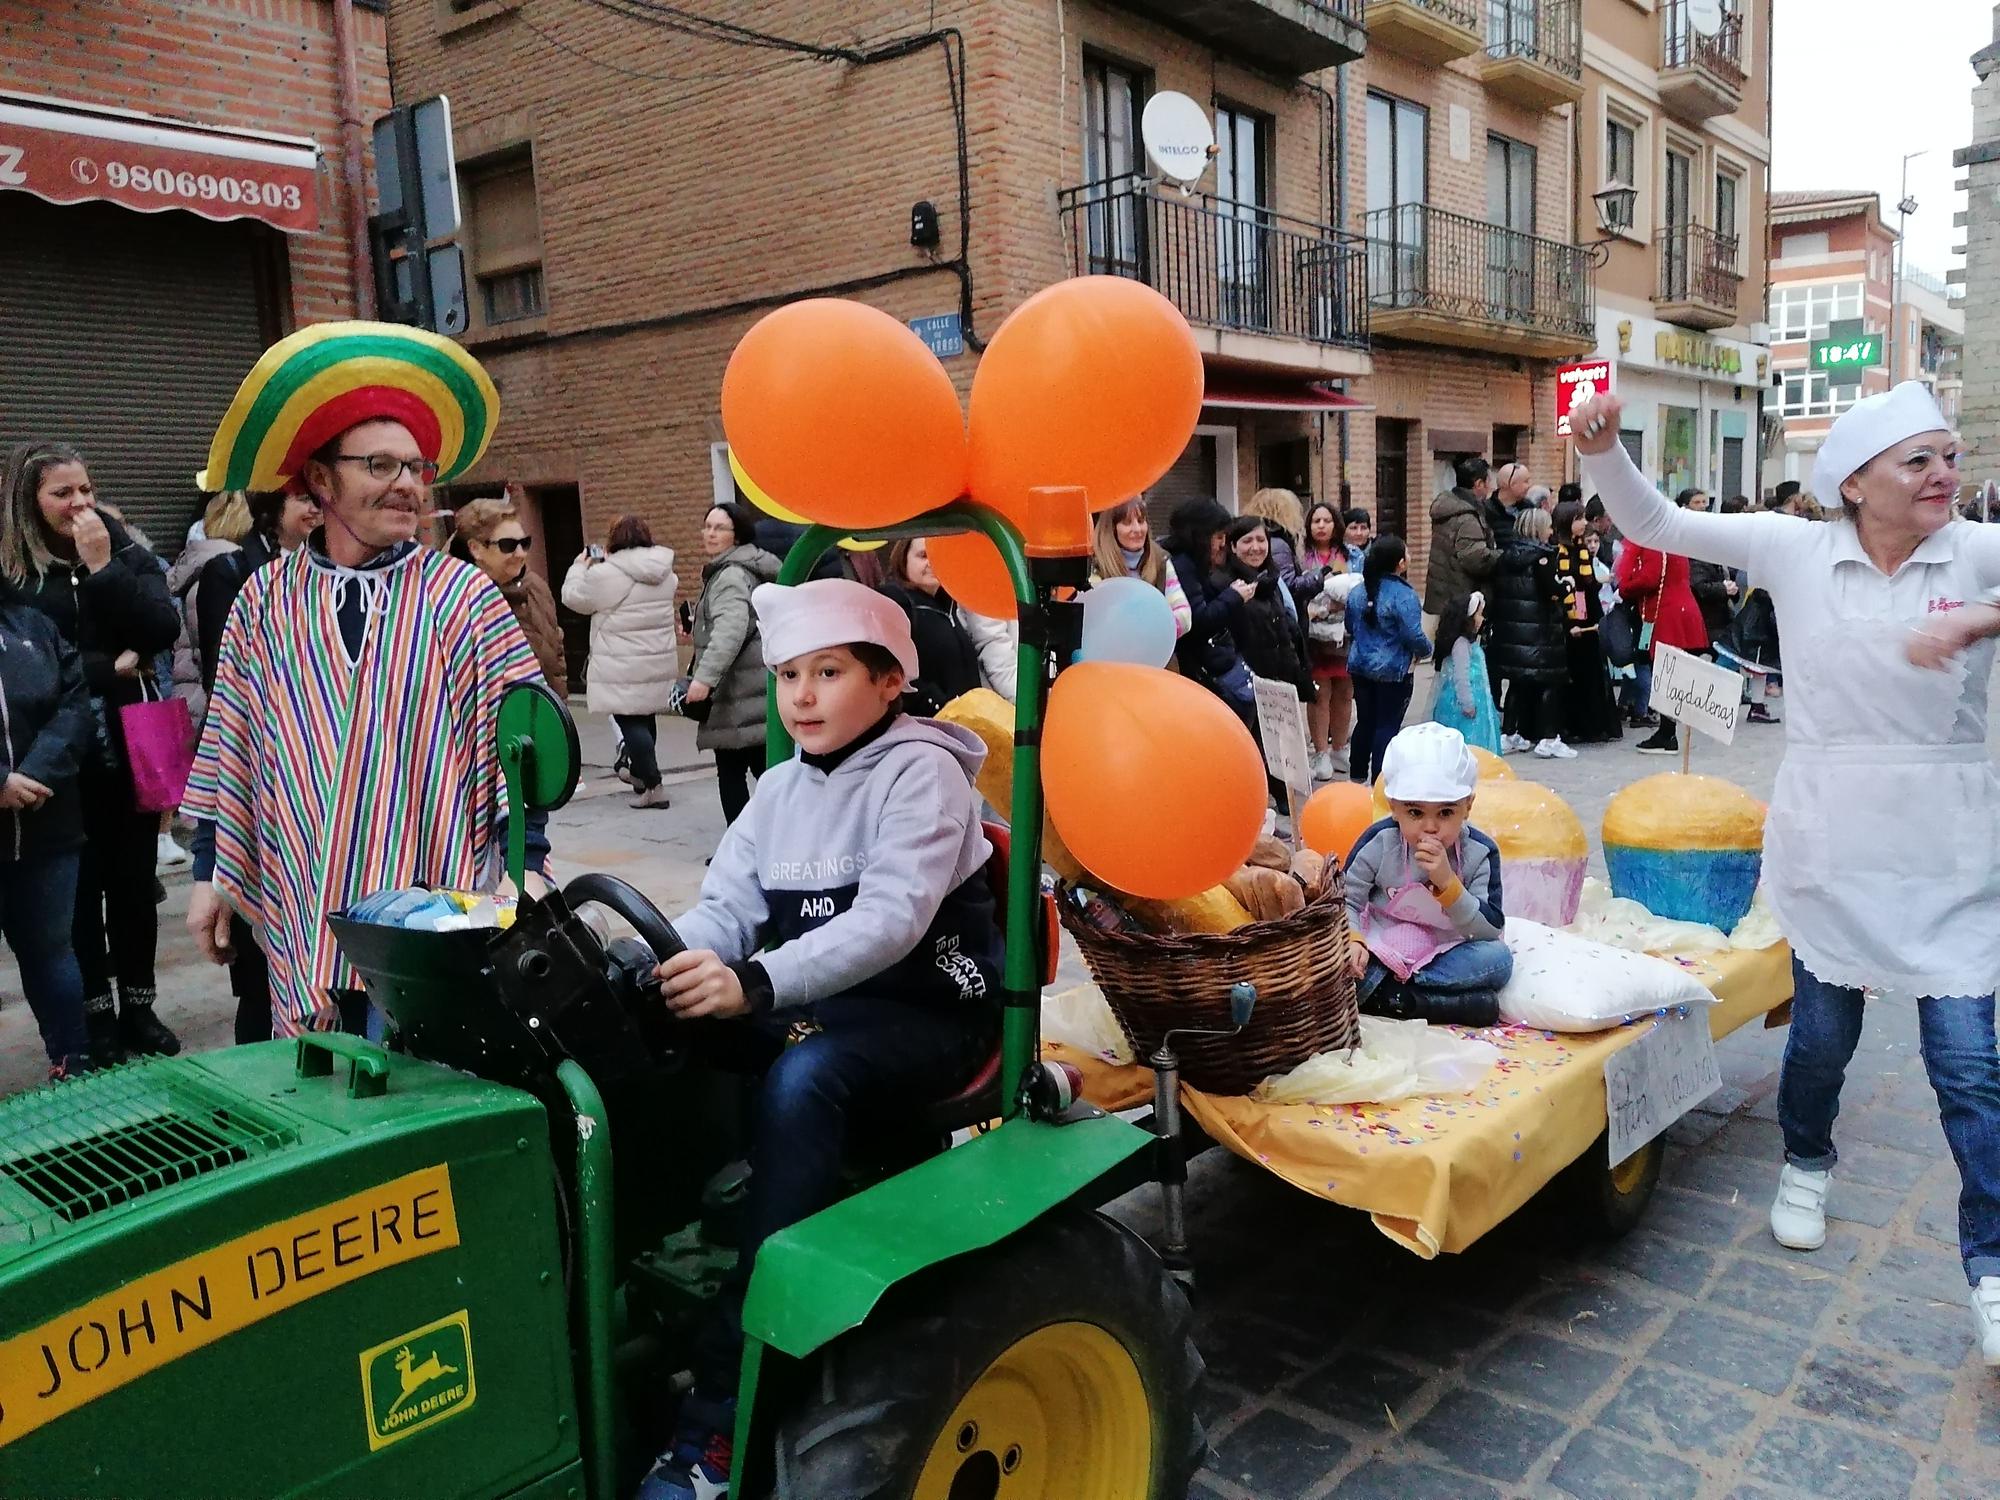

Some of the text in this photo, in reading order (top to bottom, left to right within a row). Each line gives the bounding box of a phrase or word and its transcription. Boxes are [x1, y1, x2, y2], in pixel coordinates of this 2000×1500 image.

[106, 161, 301, 210] 980690303
[927, 317, 950, 330] CALLE
[1653, 652, 1734, 729] Magdalenas
[770, 852, 867, 881] GREATINGS
[38, 1189, 441, 1399] JOHN DEERE
[381, 1384, 465, 1432] JOHN DEERE
